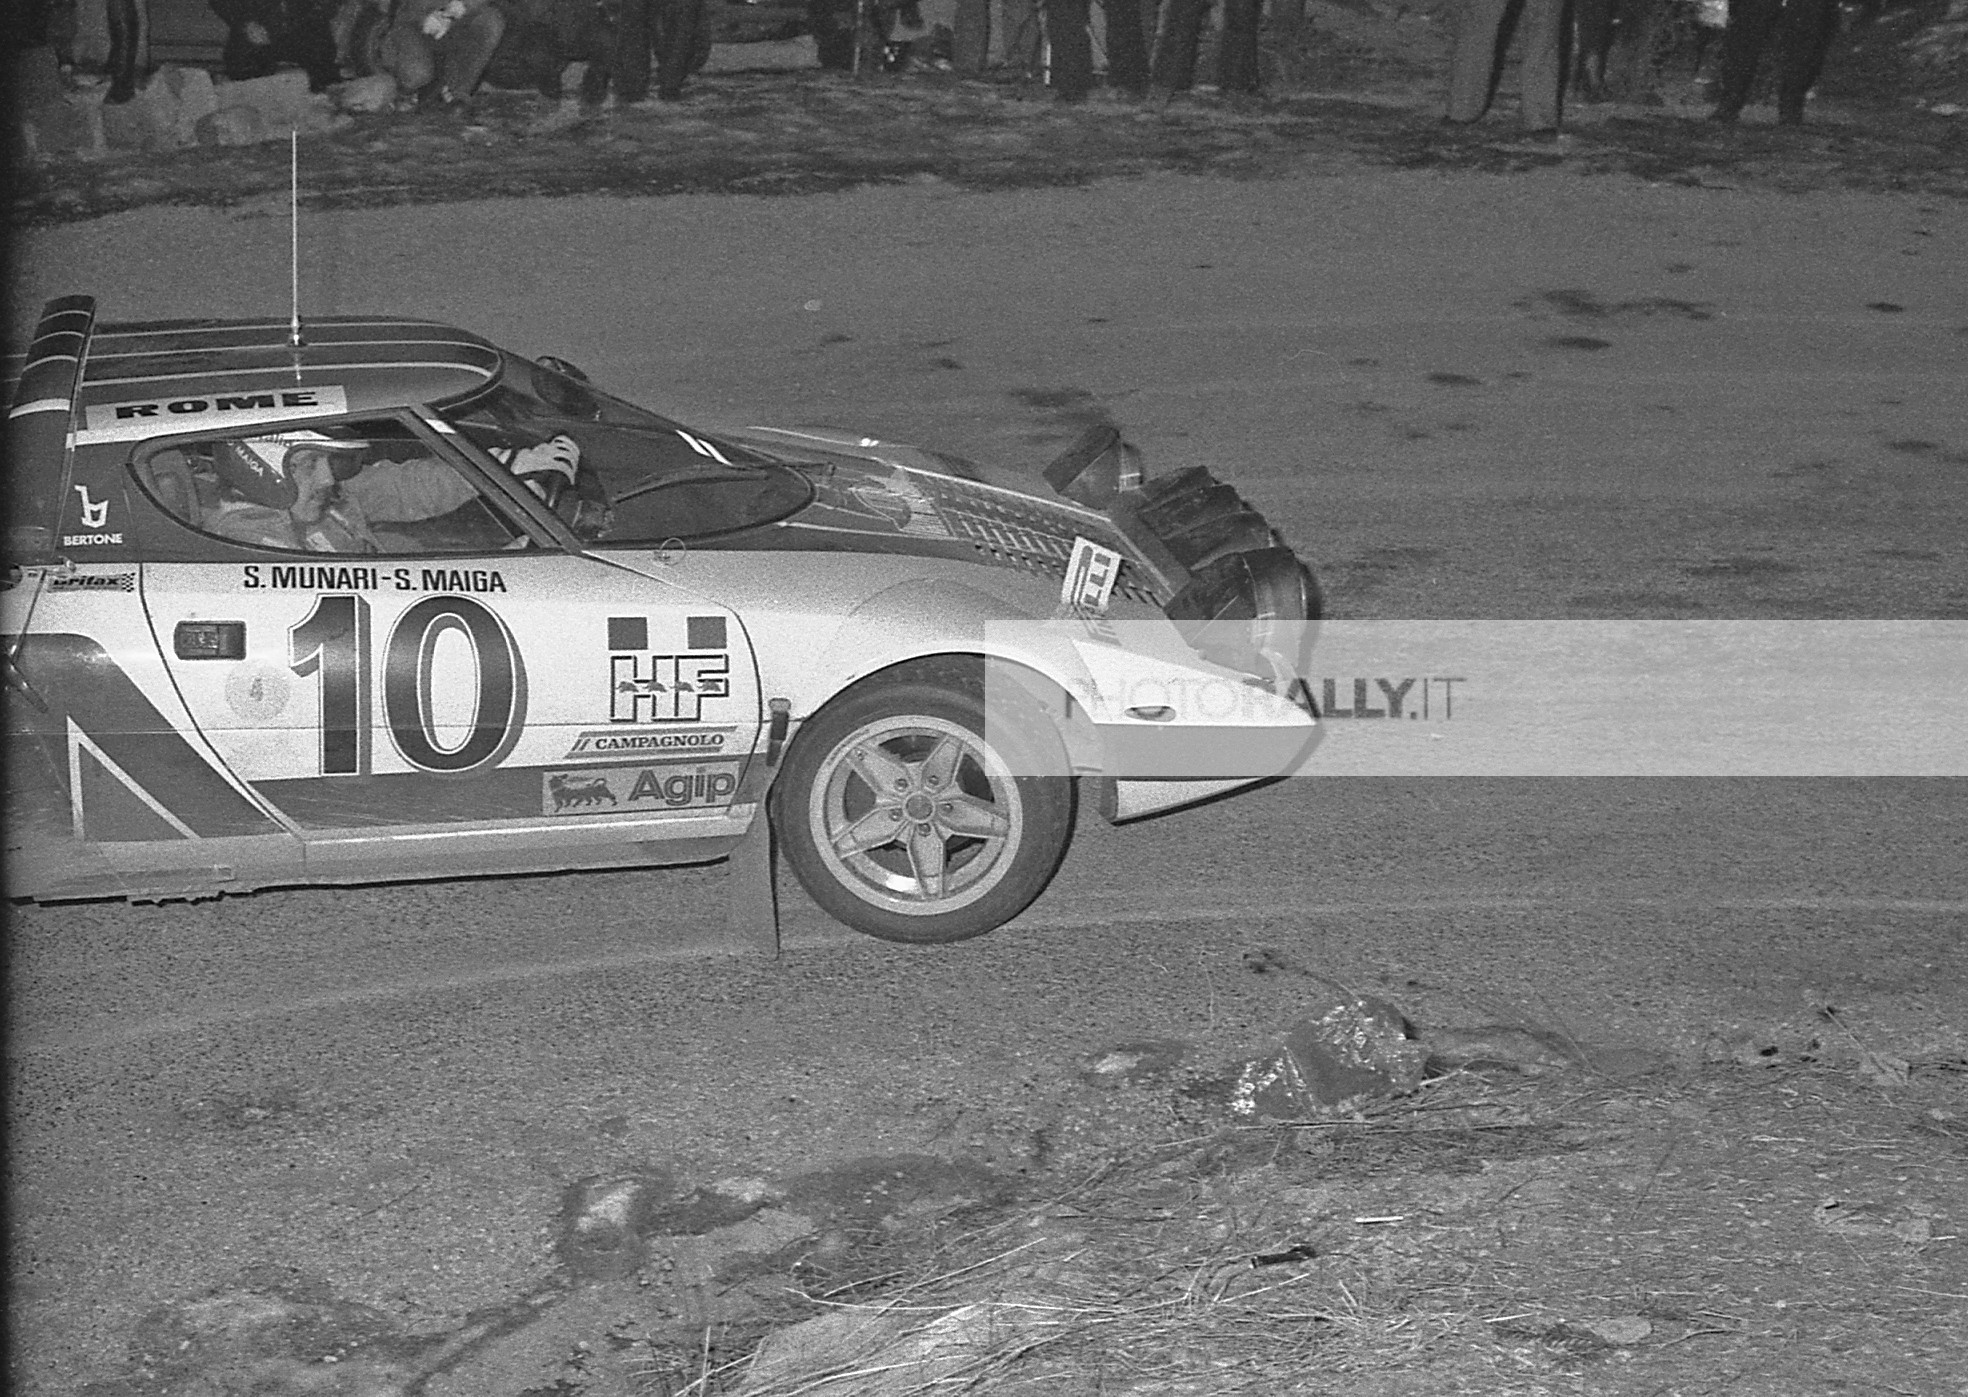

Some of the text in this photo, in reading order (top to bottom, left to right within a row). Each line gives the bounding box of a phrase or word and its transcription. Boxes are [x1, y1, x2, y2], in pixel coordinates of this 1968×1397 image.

[115, 391, 319, 419] ROME
[63, 533, 123, 546] BERTONE
[243, 565, 266, 588] S.
[422, 569, 507, 593] MAIGA
[287, 592, 529, 777] 10
[610, 654, 729, 723] HF
[595, 734, 725, 750] CAMPAGNOLO
[627, 768, 737, 807] Agip
